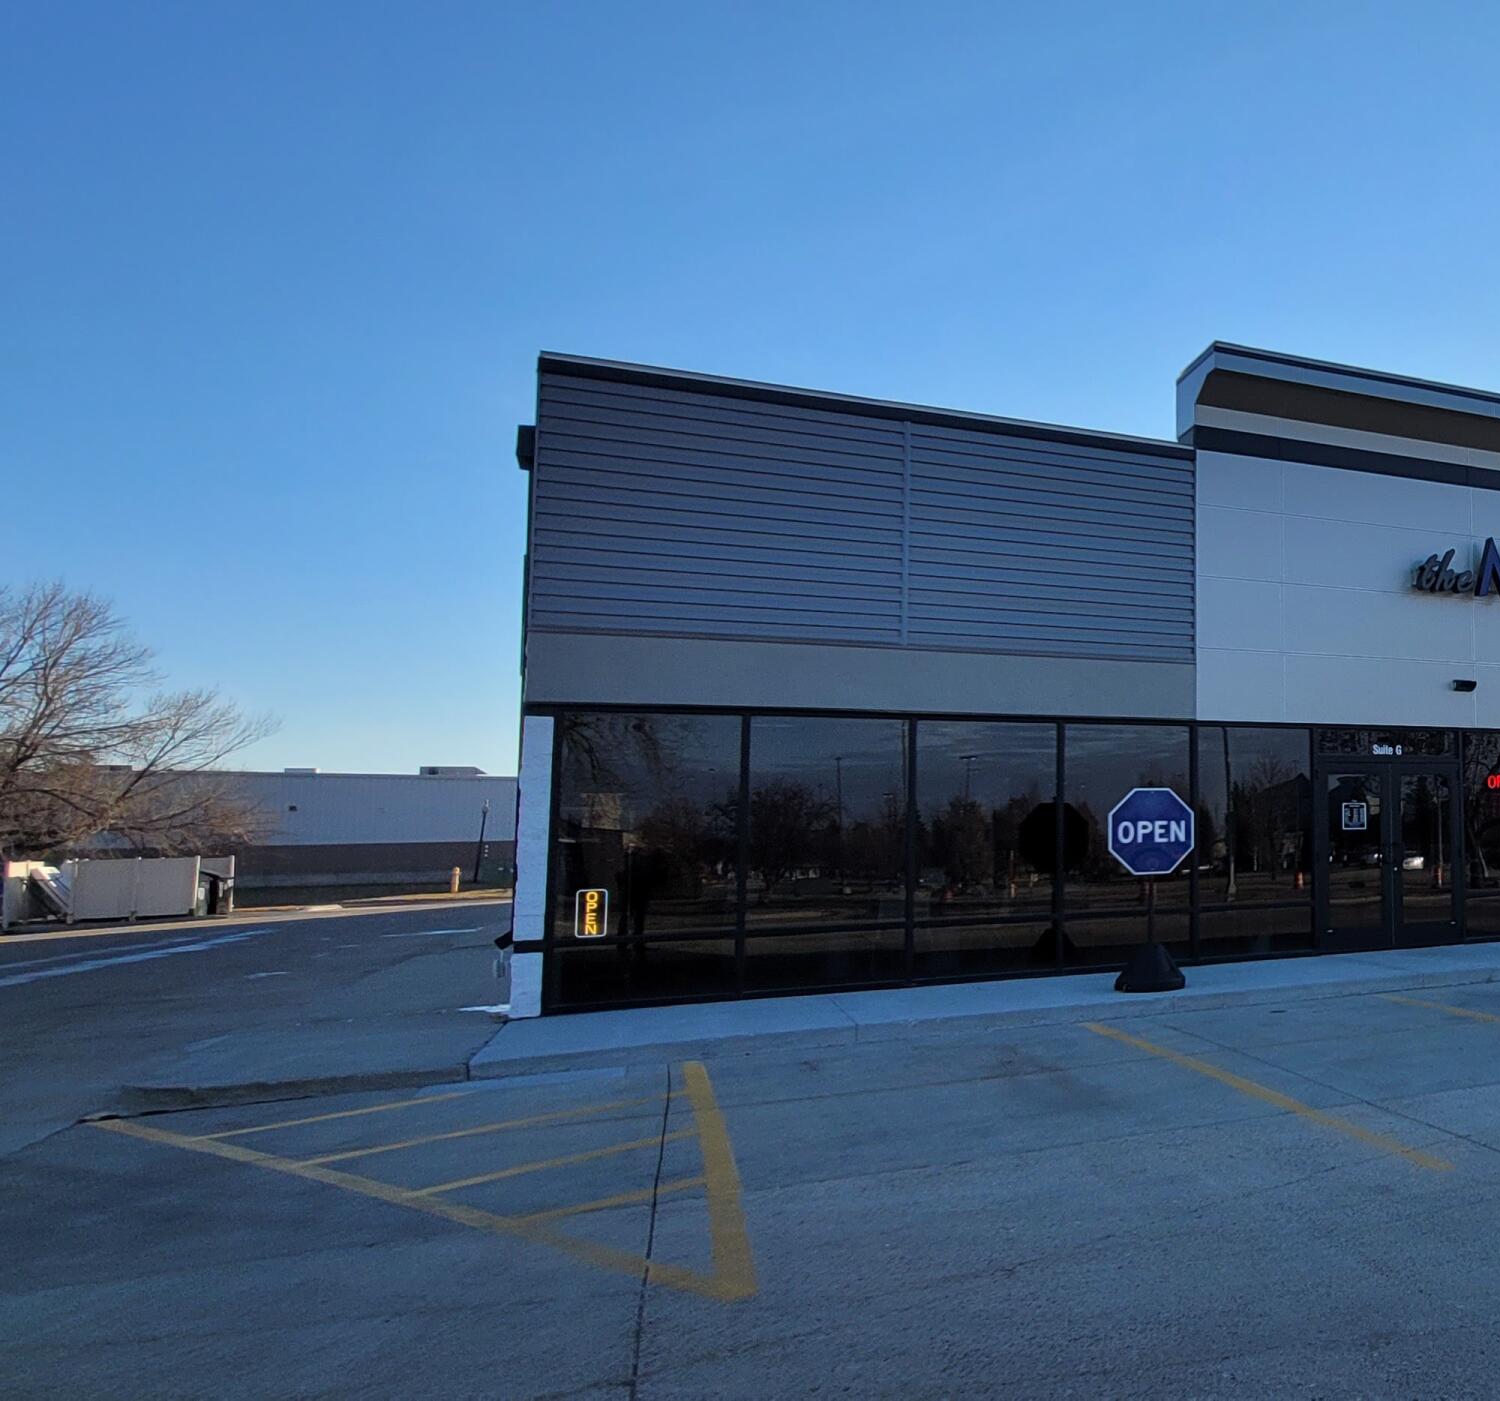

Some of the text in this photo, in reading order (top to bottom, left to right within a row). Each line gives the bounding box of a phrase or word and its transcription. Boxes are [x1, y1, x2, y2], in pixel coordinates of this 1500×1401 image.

[1411, 548, 1473, 593] the
[1372, 744, 1394, 755] Suite
[1117, 820, 1186, 844] OPEN
[585, 891, 598, 935] OPEN
